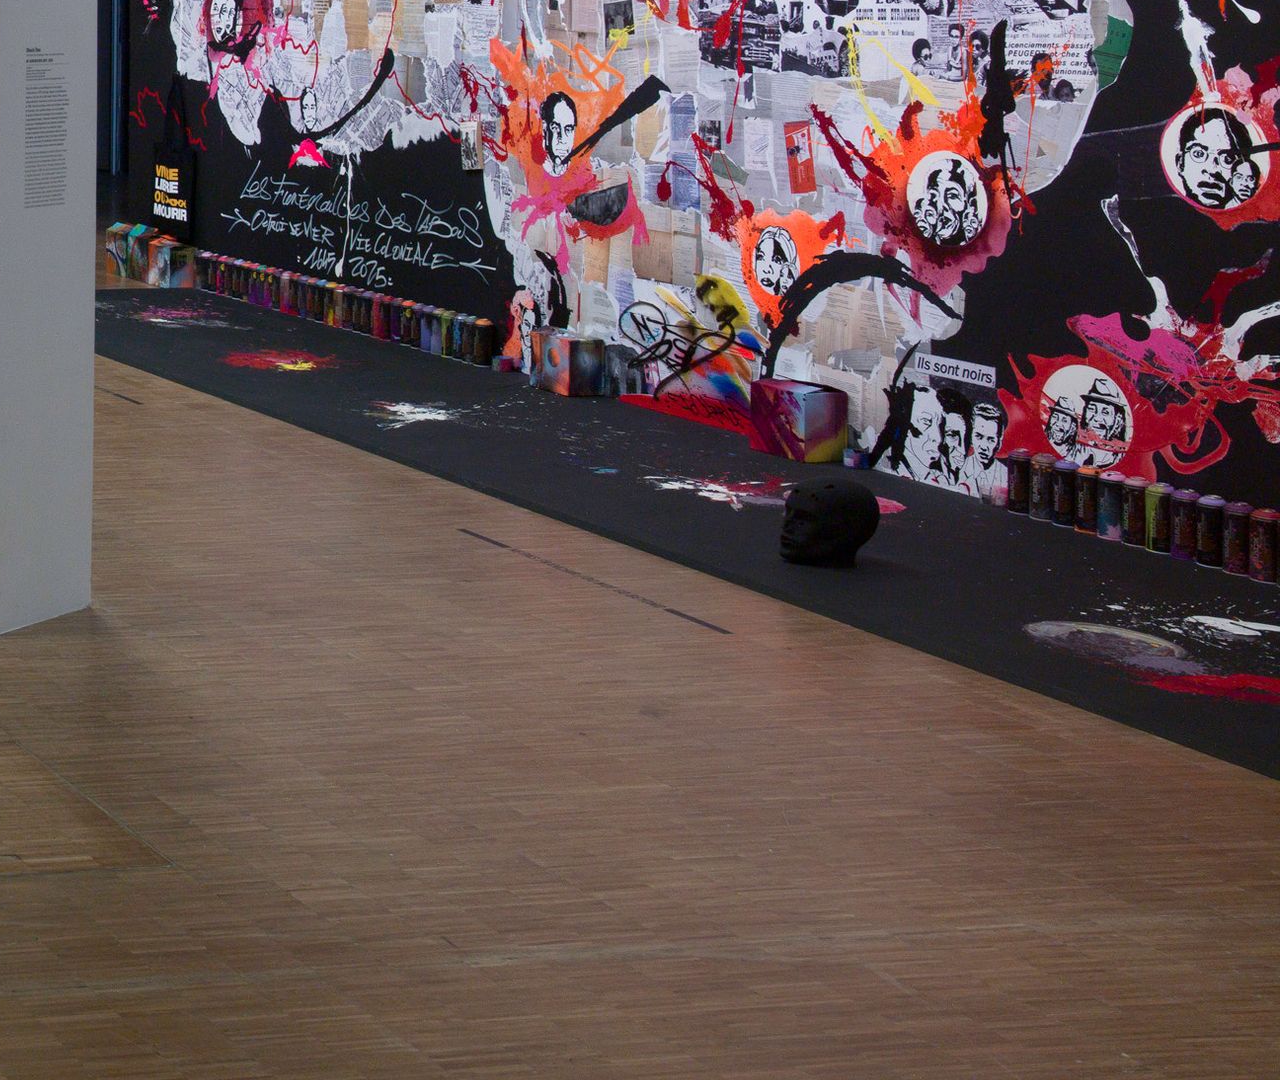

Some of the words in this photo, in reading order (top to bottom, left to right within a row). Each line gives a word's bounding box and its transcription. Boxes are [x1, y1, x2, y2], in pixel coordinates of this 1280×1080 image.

[1005, 42, 1058, 50] Licenciements
[154, 203, 187, 222] MOURIR
[917, 356, 931, 370] Ils
[933, 362, 960, 376] sont
